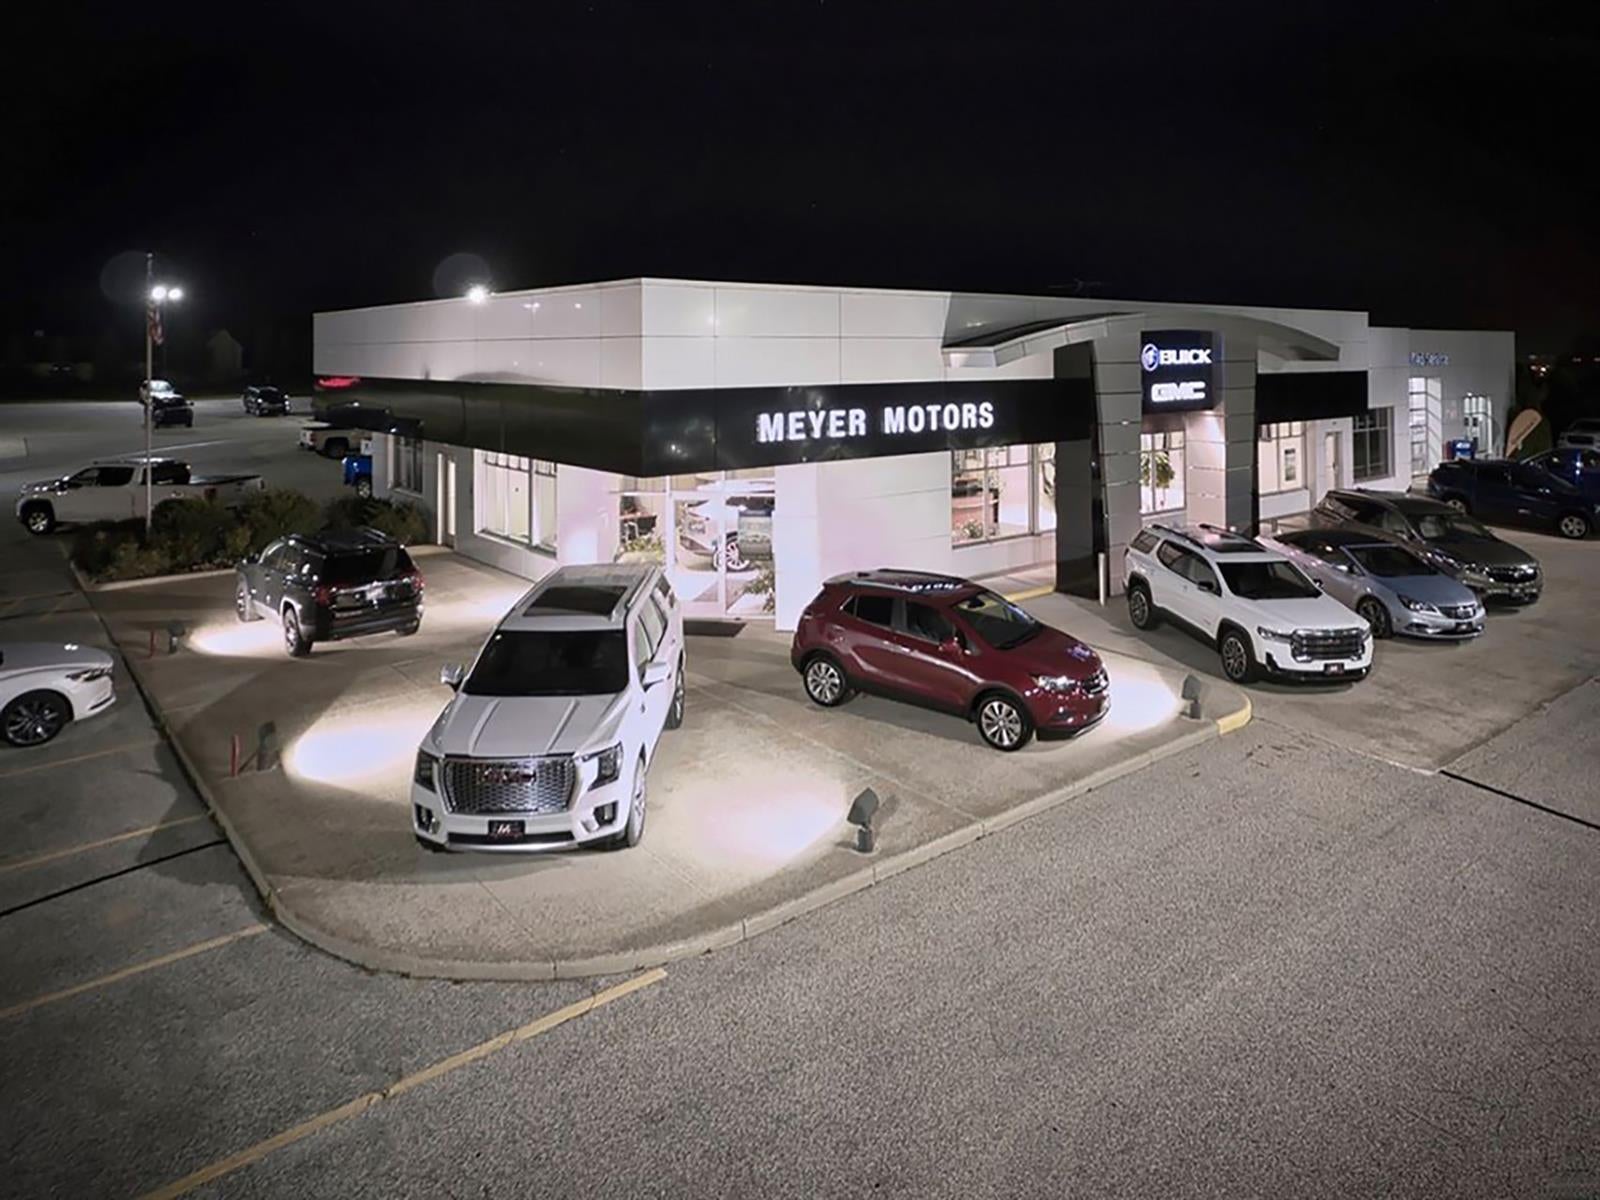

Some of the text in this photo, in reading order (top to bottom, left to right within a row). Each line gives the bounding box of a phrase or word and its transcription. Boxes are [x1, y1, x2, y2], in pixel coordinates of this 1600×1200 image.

[1159, 349, 1212, 365] BUICK
[1151, 381, 1206, 402] GMC
[757, 402, 994, 443] MEYER MOTORS
